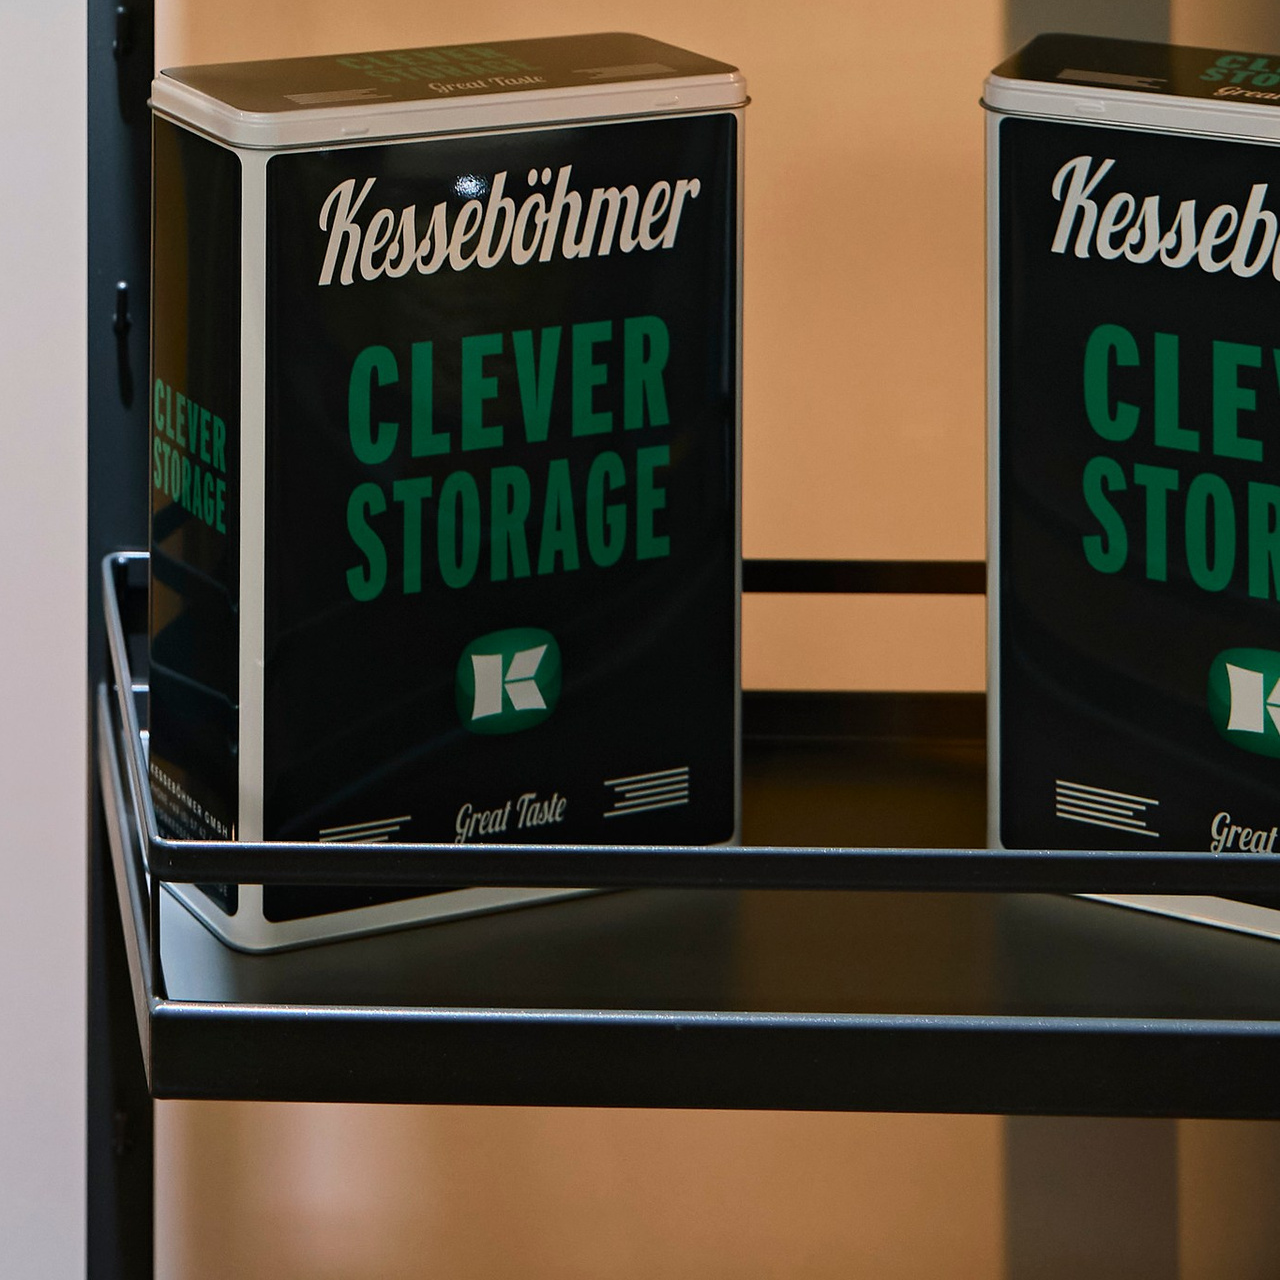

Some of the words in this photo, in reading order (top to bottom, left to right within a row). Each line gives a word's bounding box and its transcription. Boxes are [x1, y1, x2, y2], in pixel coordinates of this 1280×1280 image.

[319, 164, 700, 286] Kesseböhmer
[1050, 155, 1280, 282] Kesseb
[153, 377, 226, 474] CLEVER
[347, 314, 671, 466] CLEVER
[1083, 323, 1280, 463] CLE
[153, 436, 226, 534] STORAGE
[345, 444, 671, 603] STORAGE
[455, 800, 512, 844] Great
[516, 792, 567, 828] Taste
